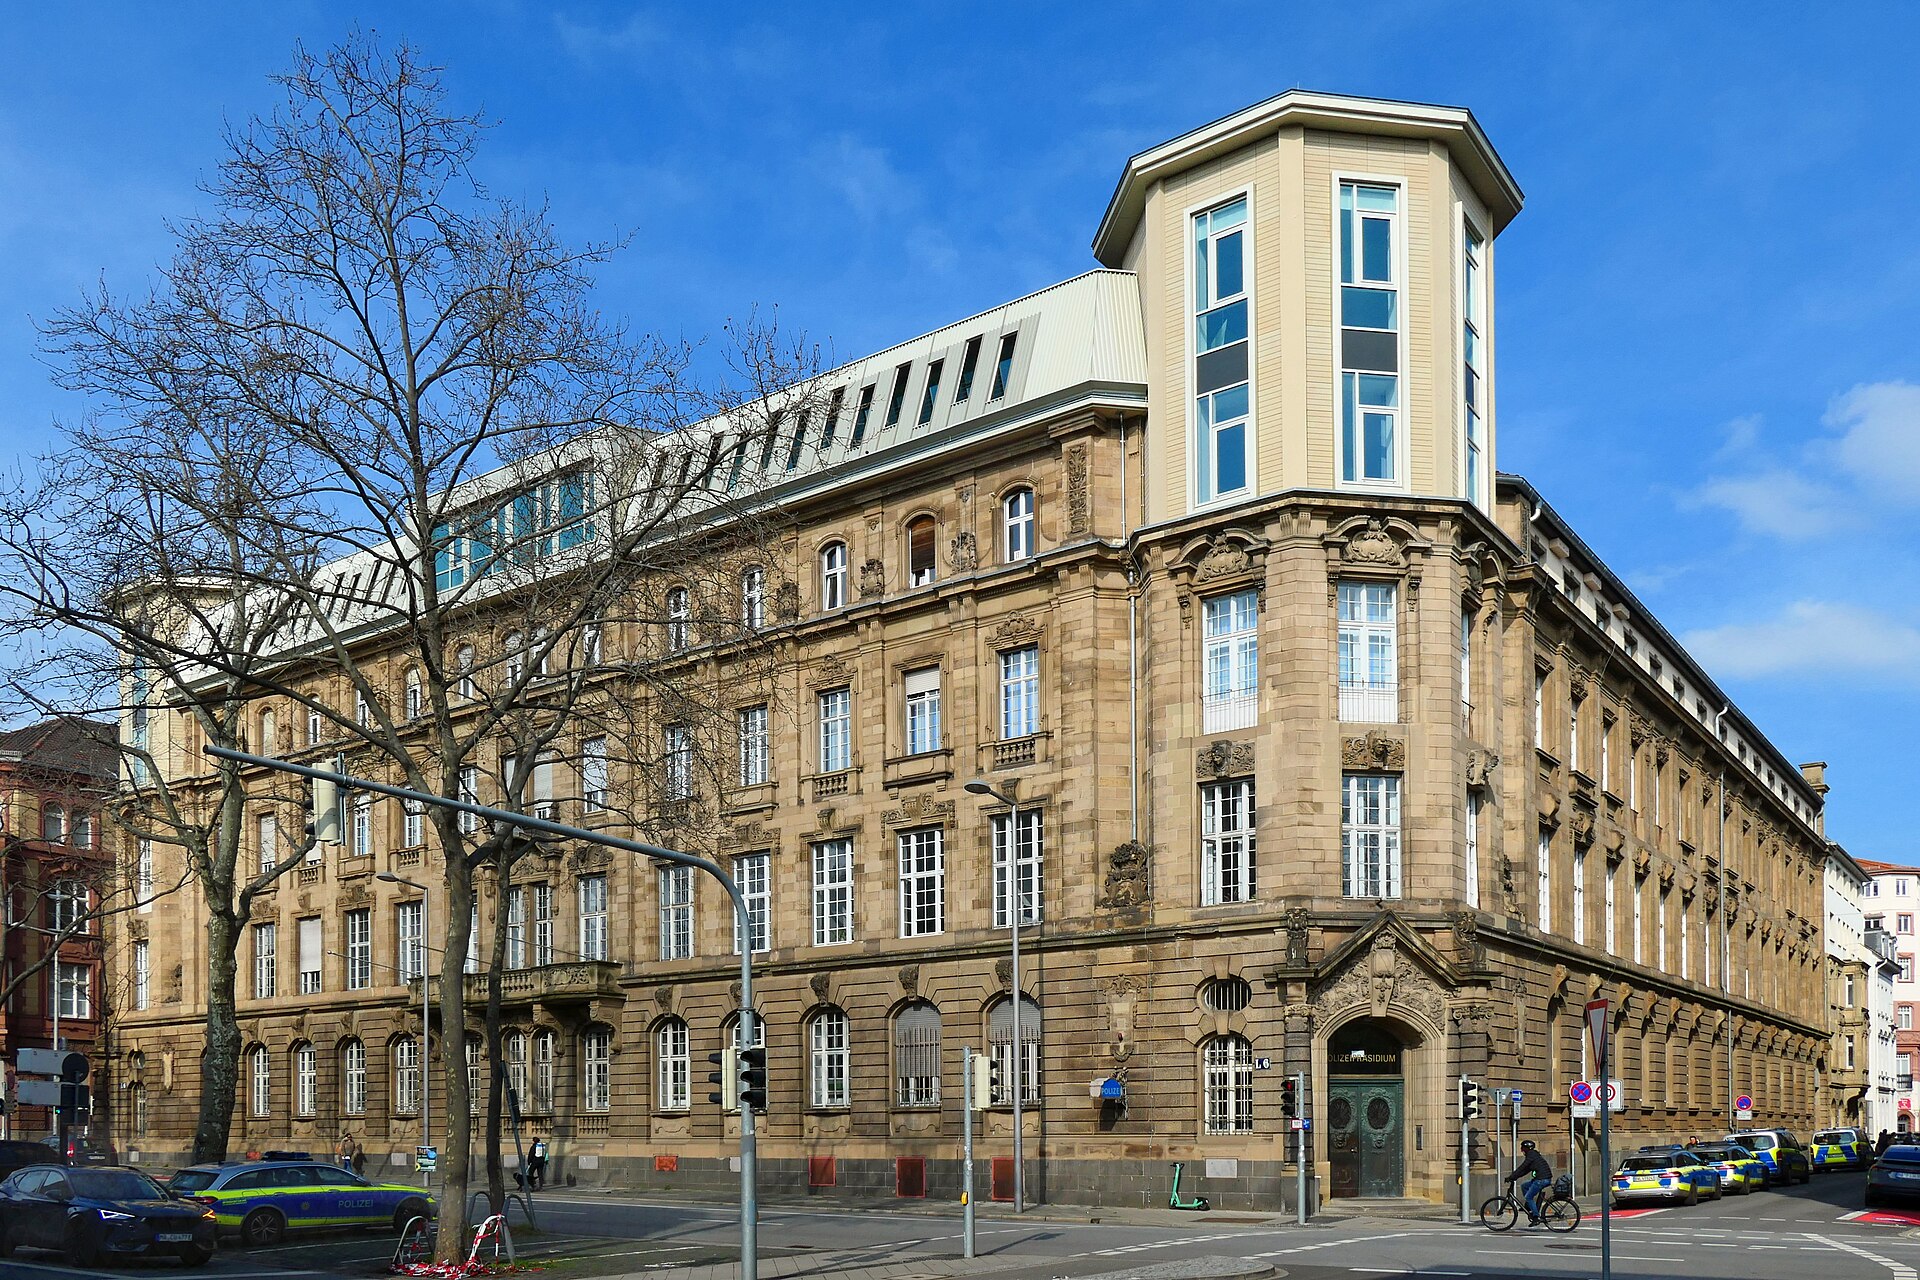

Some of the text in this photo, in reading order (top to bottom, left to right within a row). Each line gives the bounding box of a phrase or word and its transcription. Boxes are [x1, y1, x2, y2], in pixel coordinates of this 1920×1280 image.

[1328, 1054, 1396, 1063] OLIZEIPRÄSIDIUM
[1255, 1058, 1270, 1069] L 6
[1102, 1087, 1121, 1095] POLIZE
[338, 1199, 374, 1208] POLIZEI
